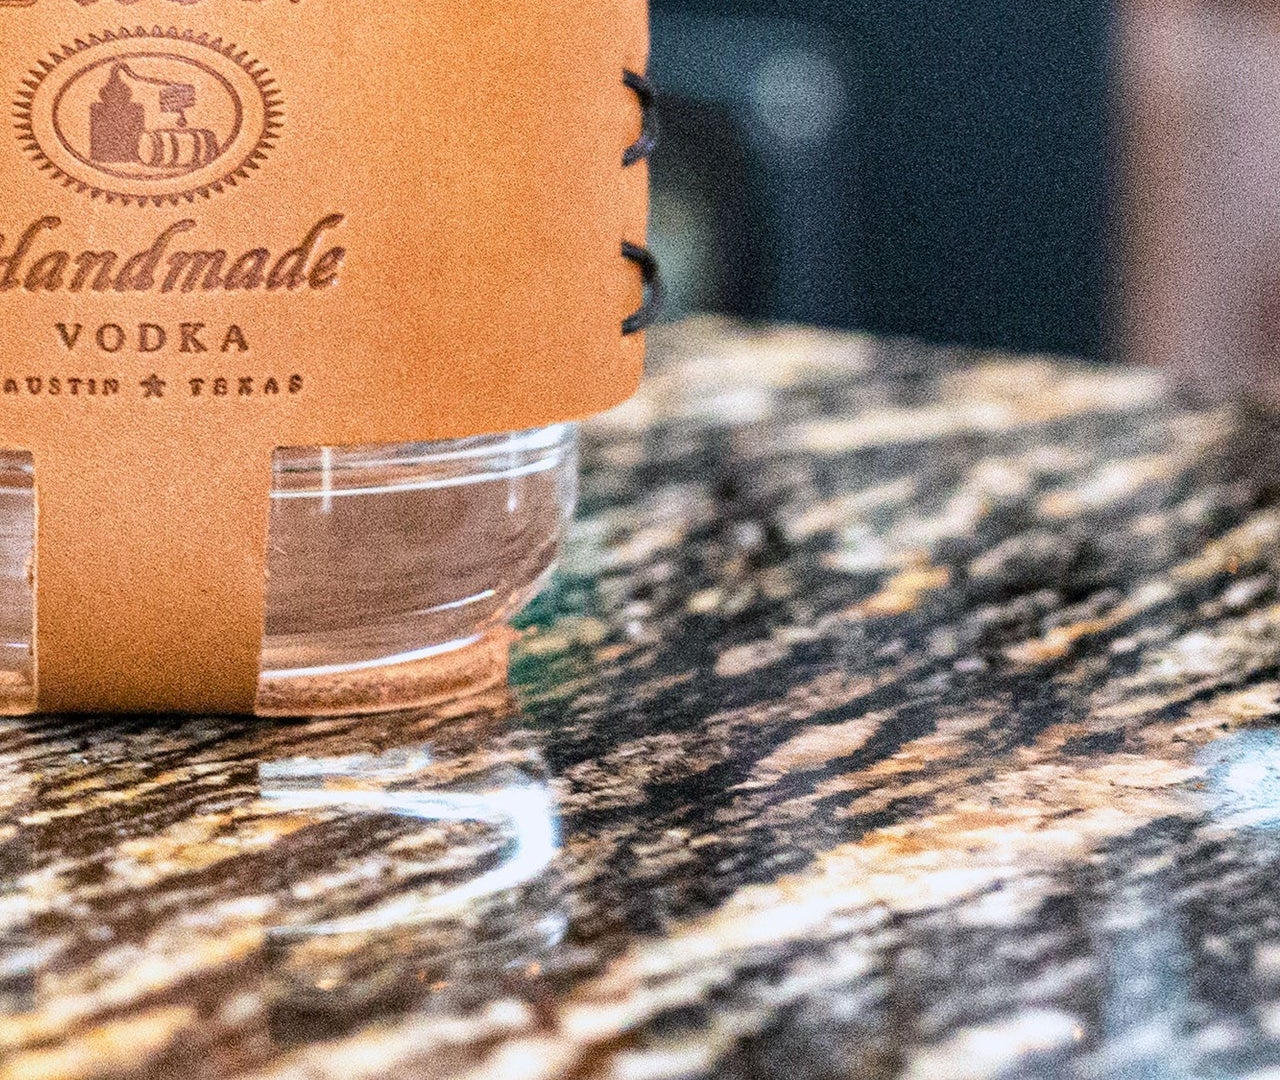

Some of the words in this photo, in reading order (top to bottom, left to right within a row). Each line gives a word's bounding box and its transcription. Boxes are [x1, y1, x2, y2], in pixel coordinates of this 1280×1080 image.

[55, 322, 250, 353] VODKA
[3, 376, 121, 396] AUSTIN
[188, 374, 304, 396] TEXAS
